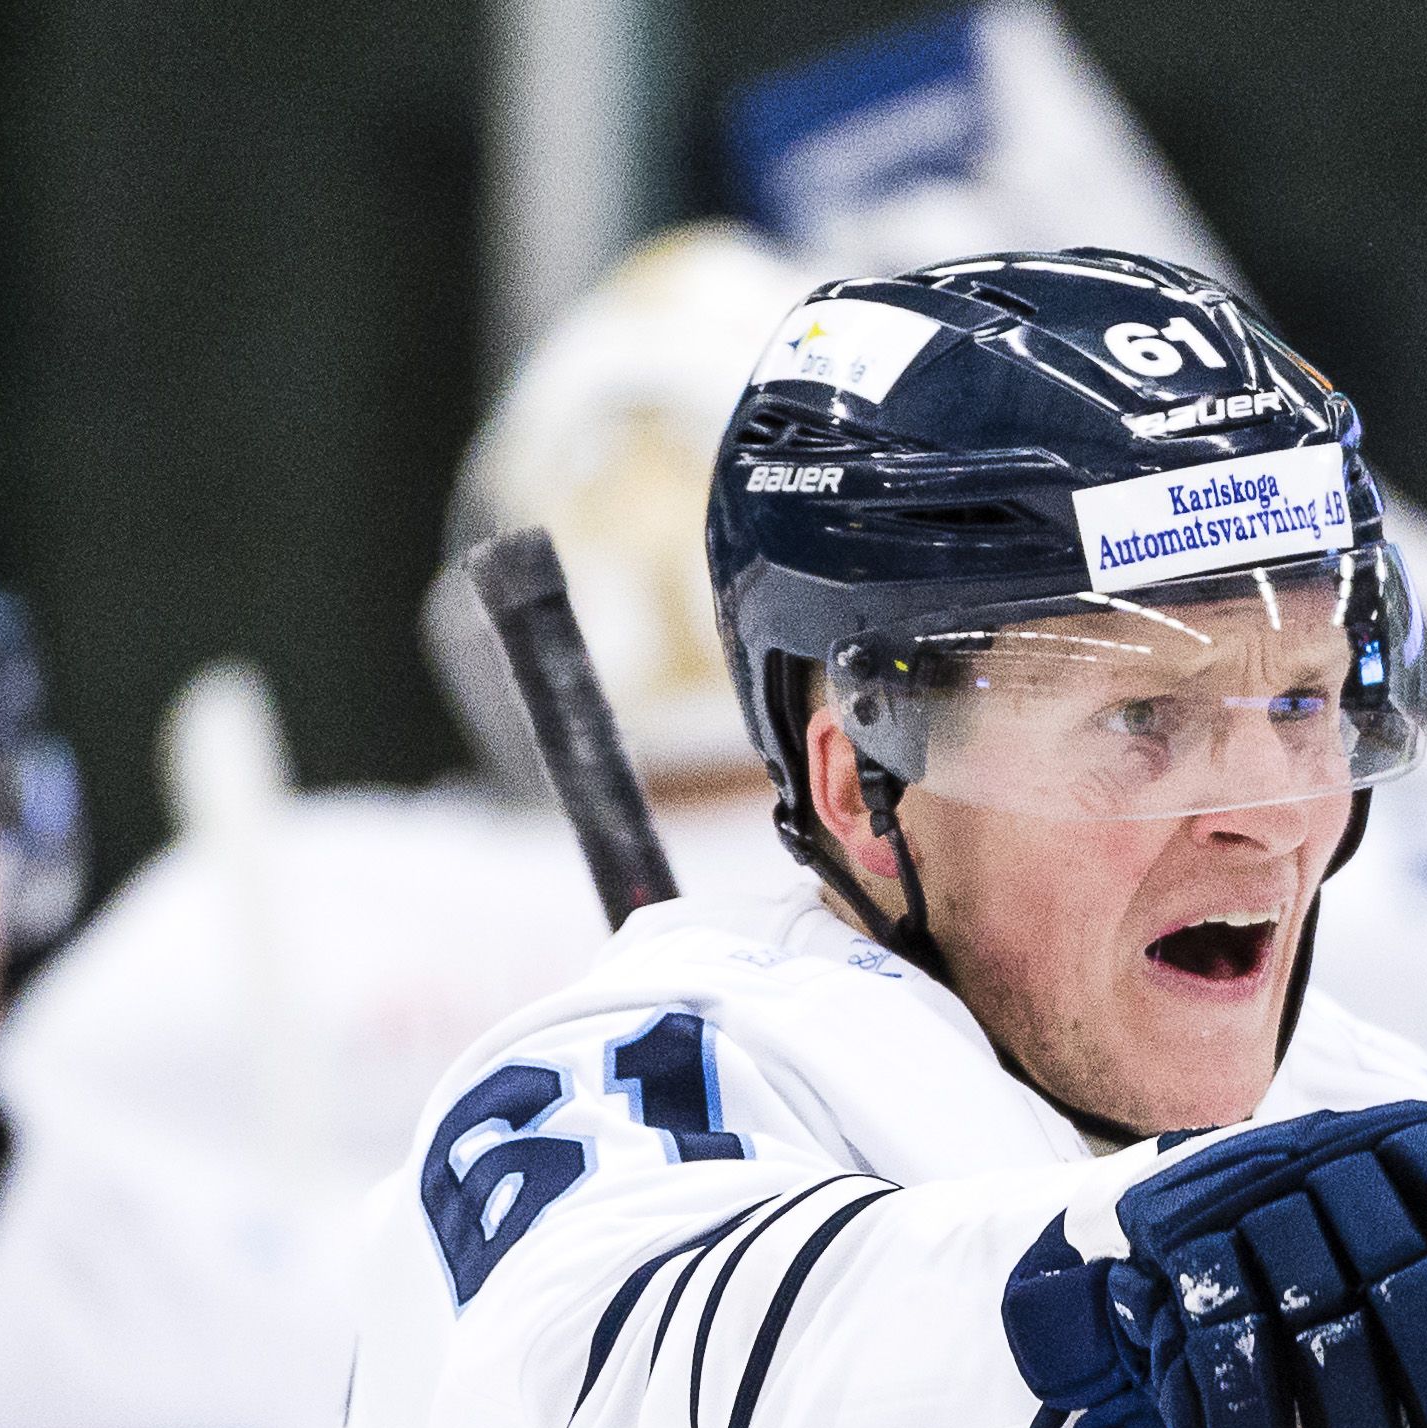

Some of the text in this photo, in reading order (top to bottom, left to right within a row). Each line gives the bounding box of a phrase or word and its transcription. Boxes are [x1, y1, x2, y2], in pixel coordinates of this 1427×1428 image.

[1104, 317, 1226, 377] 61
[746, 465, 844, 493] BAUER
[1168, 474, 1280, 516] Karlskoga
[1100, 490, 1346, 570] Automatsvarvning AB
[420, 1005, 752, 1315] 61
